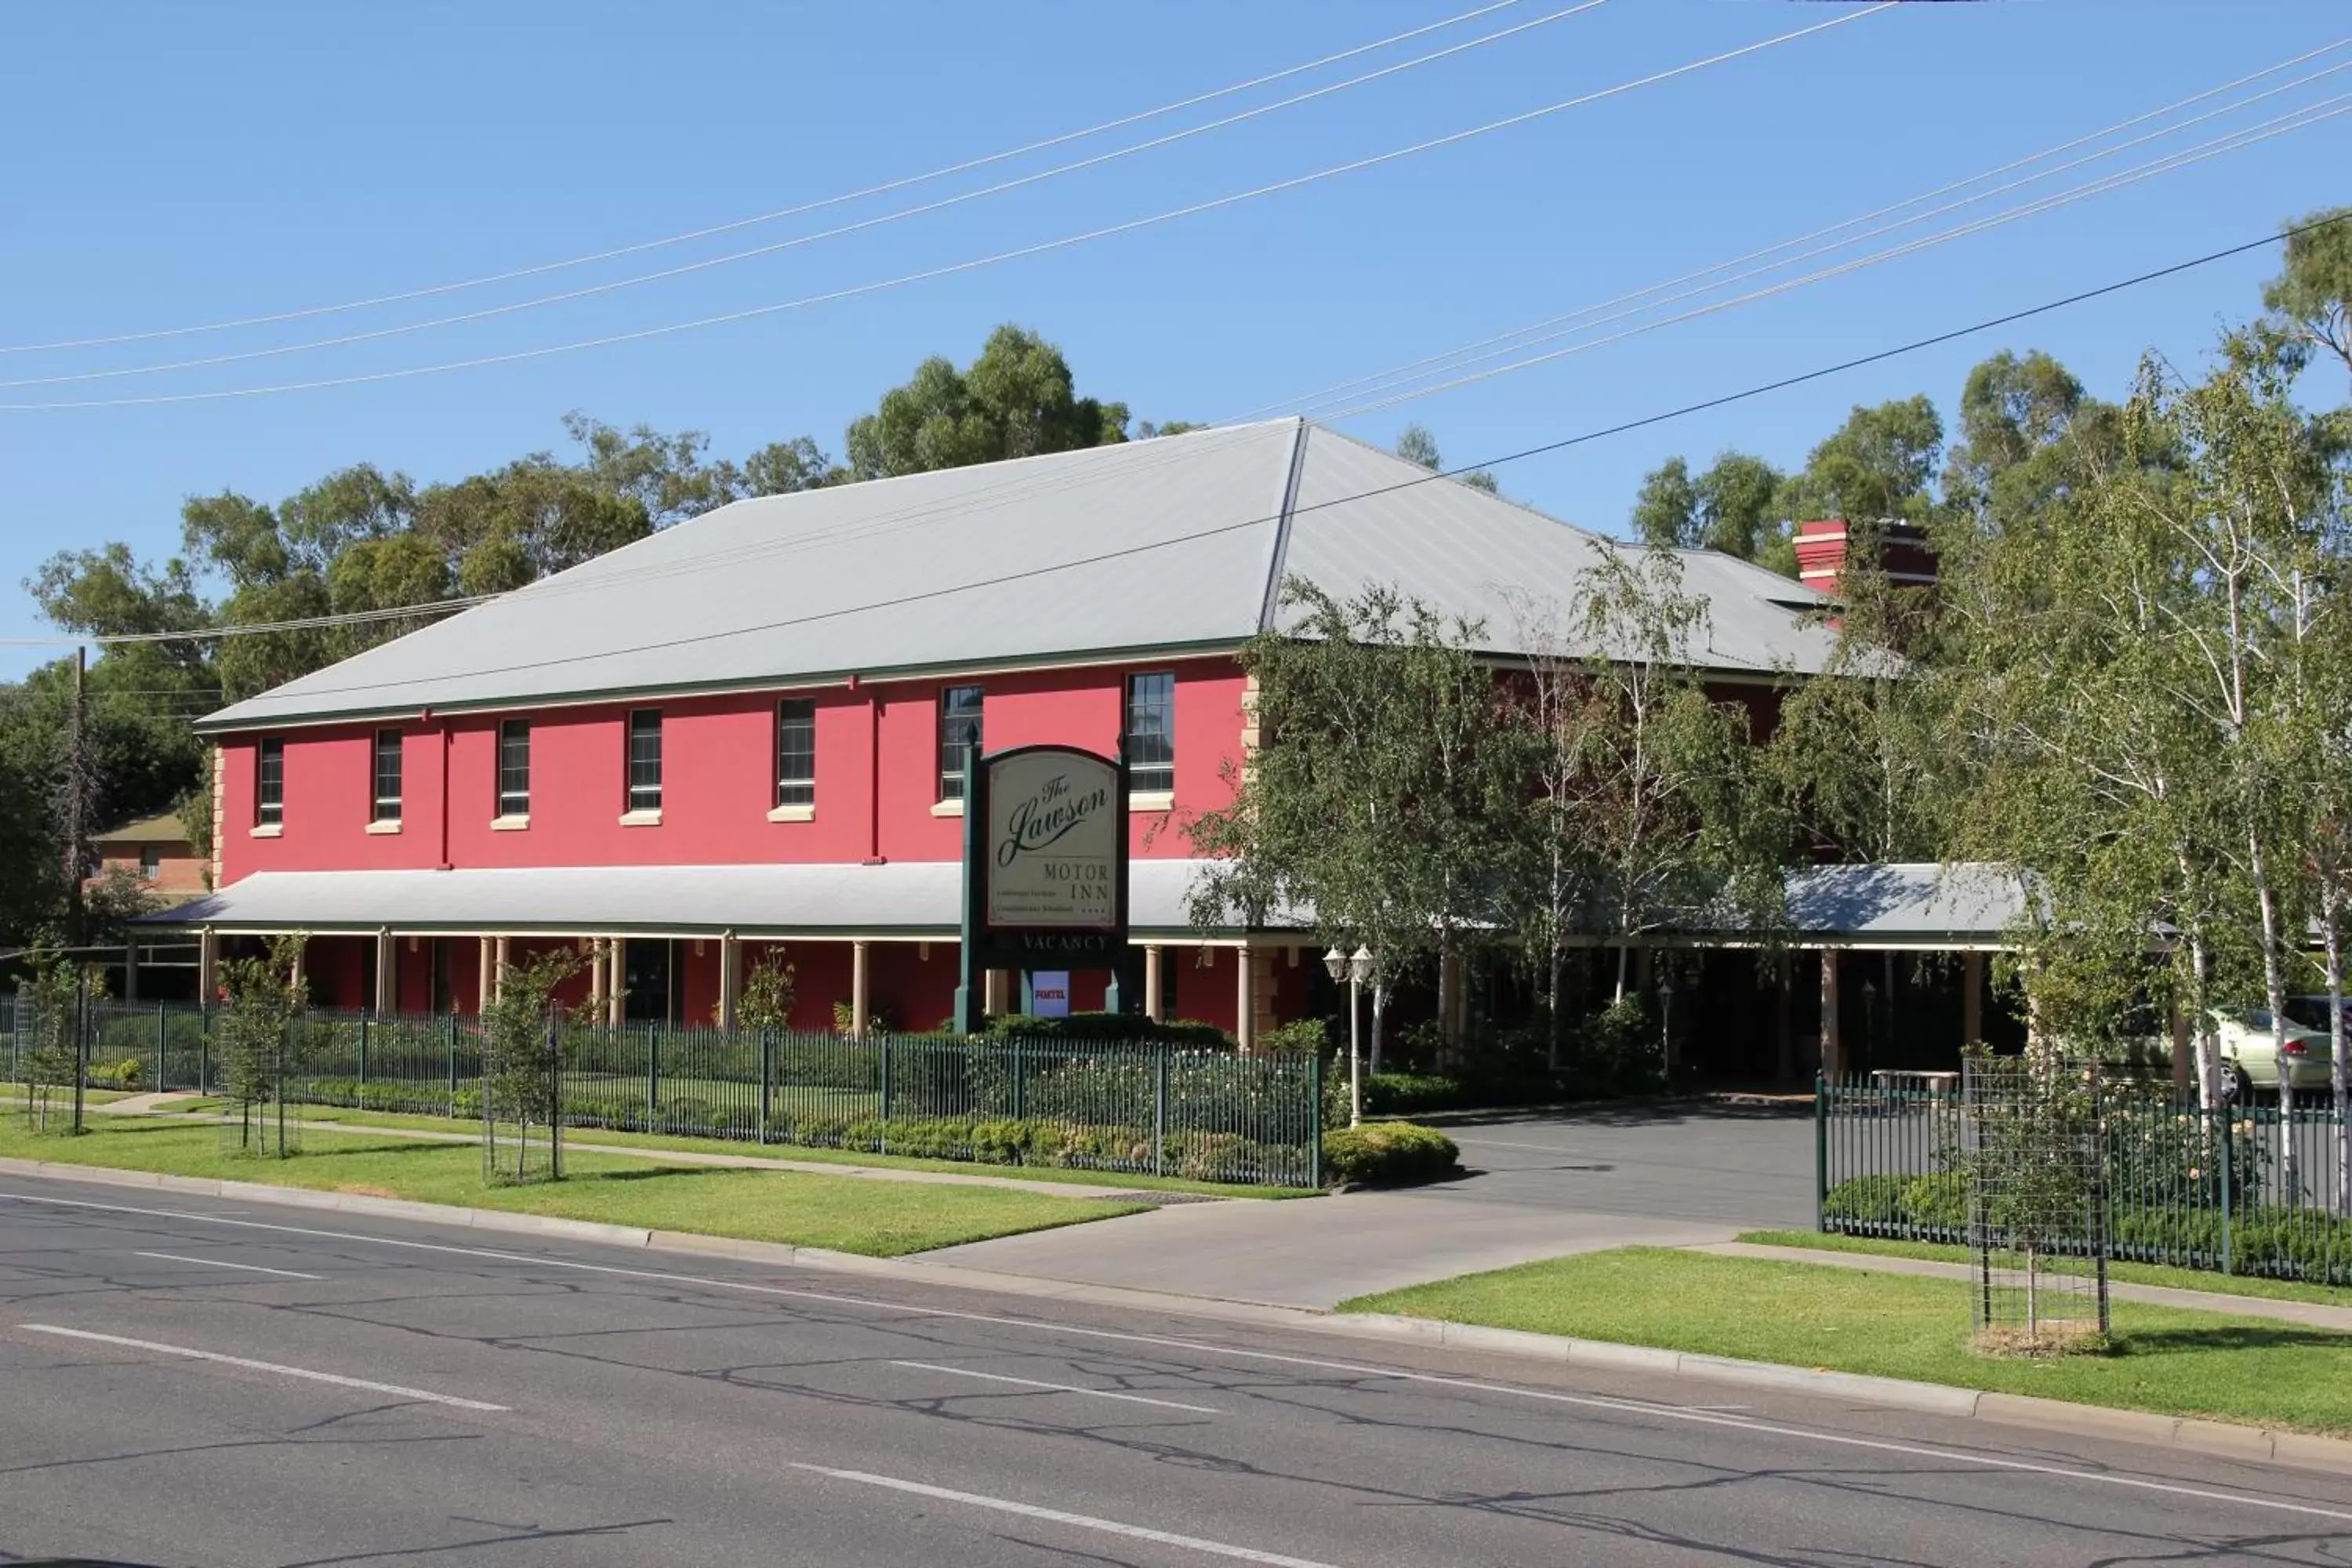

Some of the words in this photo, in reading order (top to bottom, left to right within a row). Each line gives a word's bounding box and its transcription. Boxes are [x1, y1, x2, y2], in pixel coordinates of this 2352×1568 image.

[1042, 773, 1070, 804] The
[998, 789, 1109, 868] Lawson
[1044, 863, 1108, 880] MOTOR
[1071, 884, 1108, 899] INN
[1024, 933, 1107, 950] VACANCY
